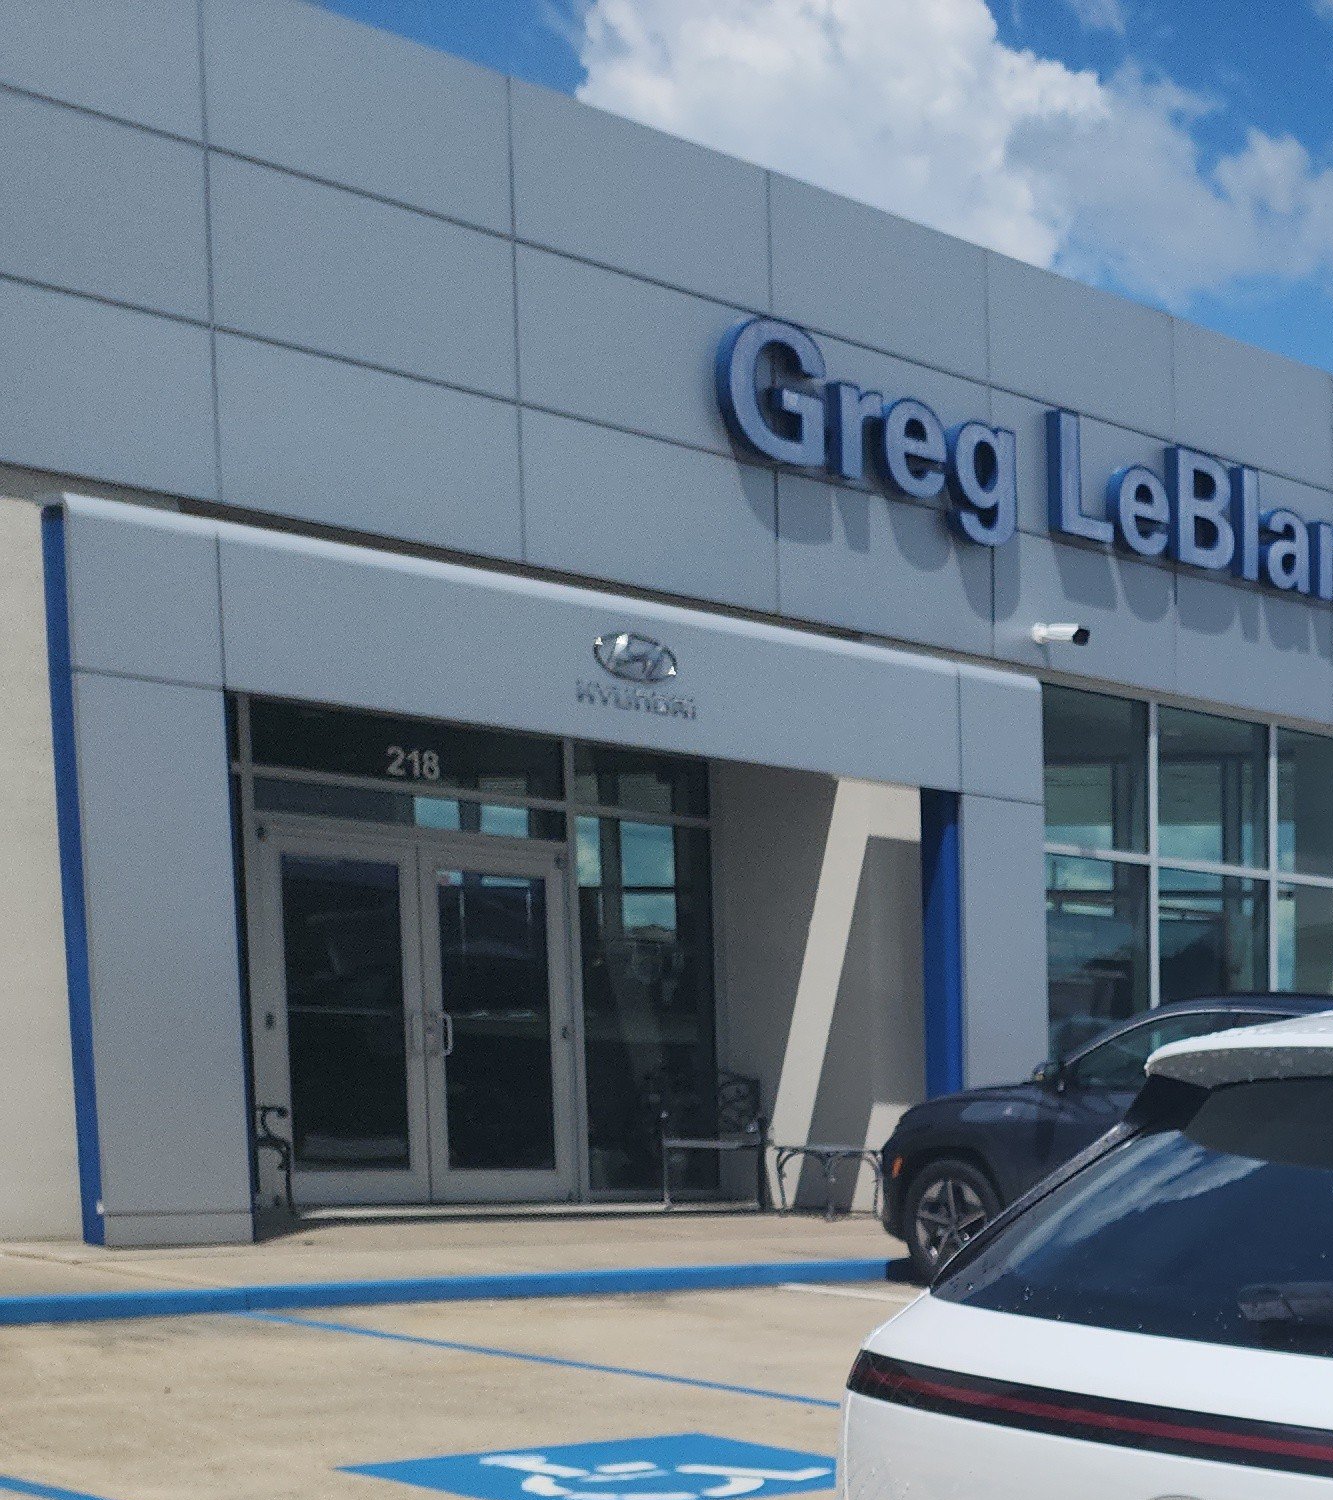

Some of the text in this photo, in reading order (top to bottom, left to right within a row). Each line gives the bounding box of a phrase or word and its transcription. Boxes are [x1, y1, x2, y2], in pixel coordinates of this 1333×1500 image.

[717, 316, 1017, 547] Greg
[575, 680, 697, 719] HYUNDAI
[386, 745, 441, 780] 218
